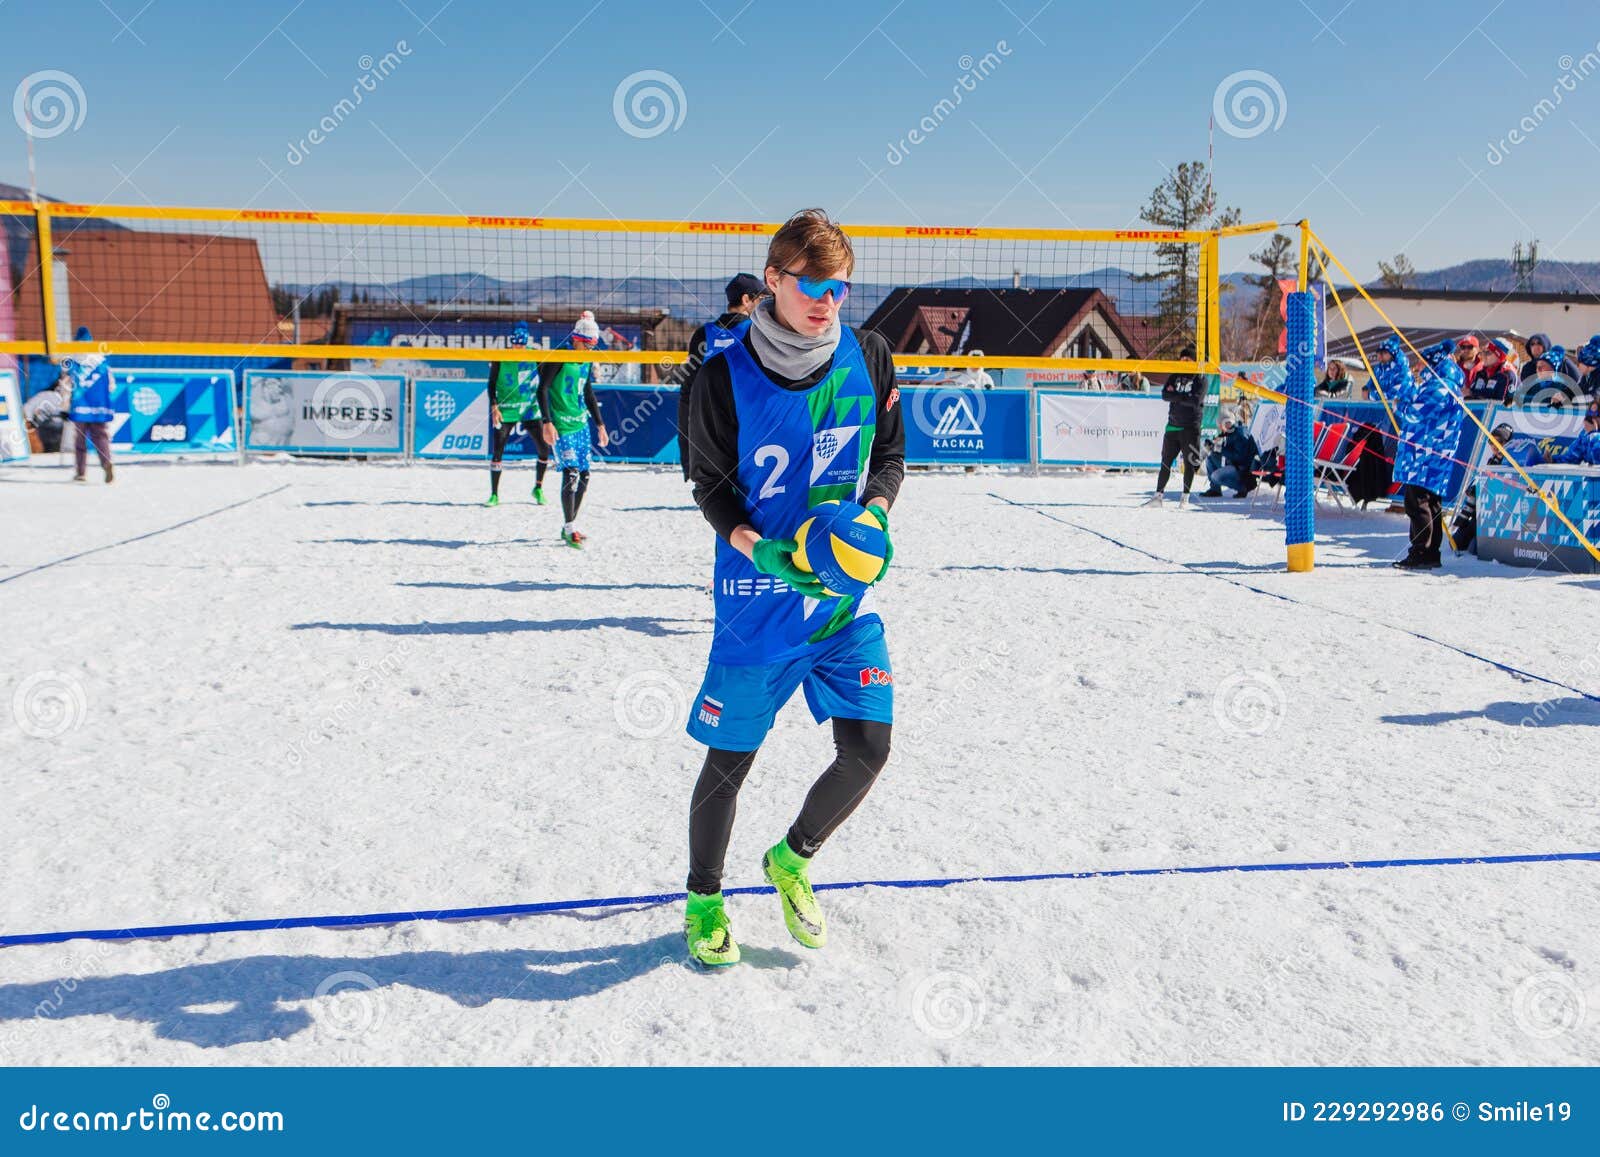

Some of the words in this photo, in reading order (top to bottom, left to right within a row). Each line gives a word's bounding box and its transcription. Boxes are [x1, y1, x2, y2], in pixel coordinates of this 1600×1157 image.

[390, 334, 550, 350] СУВЕНИЫ
[303, 406, 393, 422] IMPRESS
[442, 434, 484, 450] ВФВ
[933, 439, 985, 450] КАСКАД
[754, 444, 790, 500] 2
[698, 708, 720, 728] RUS
